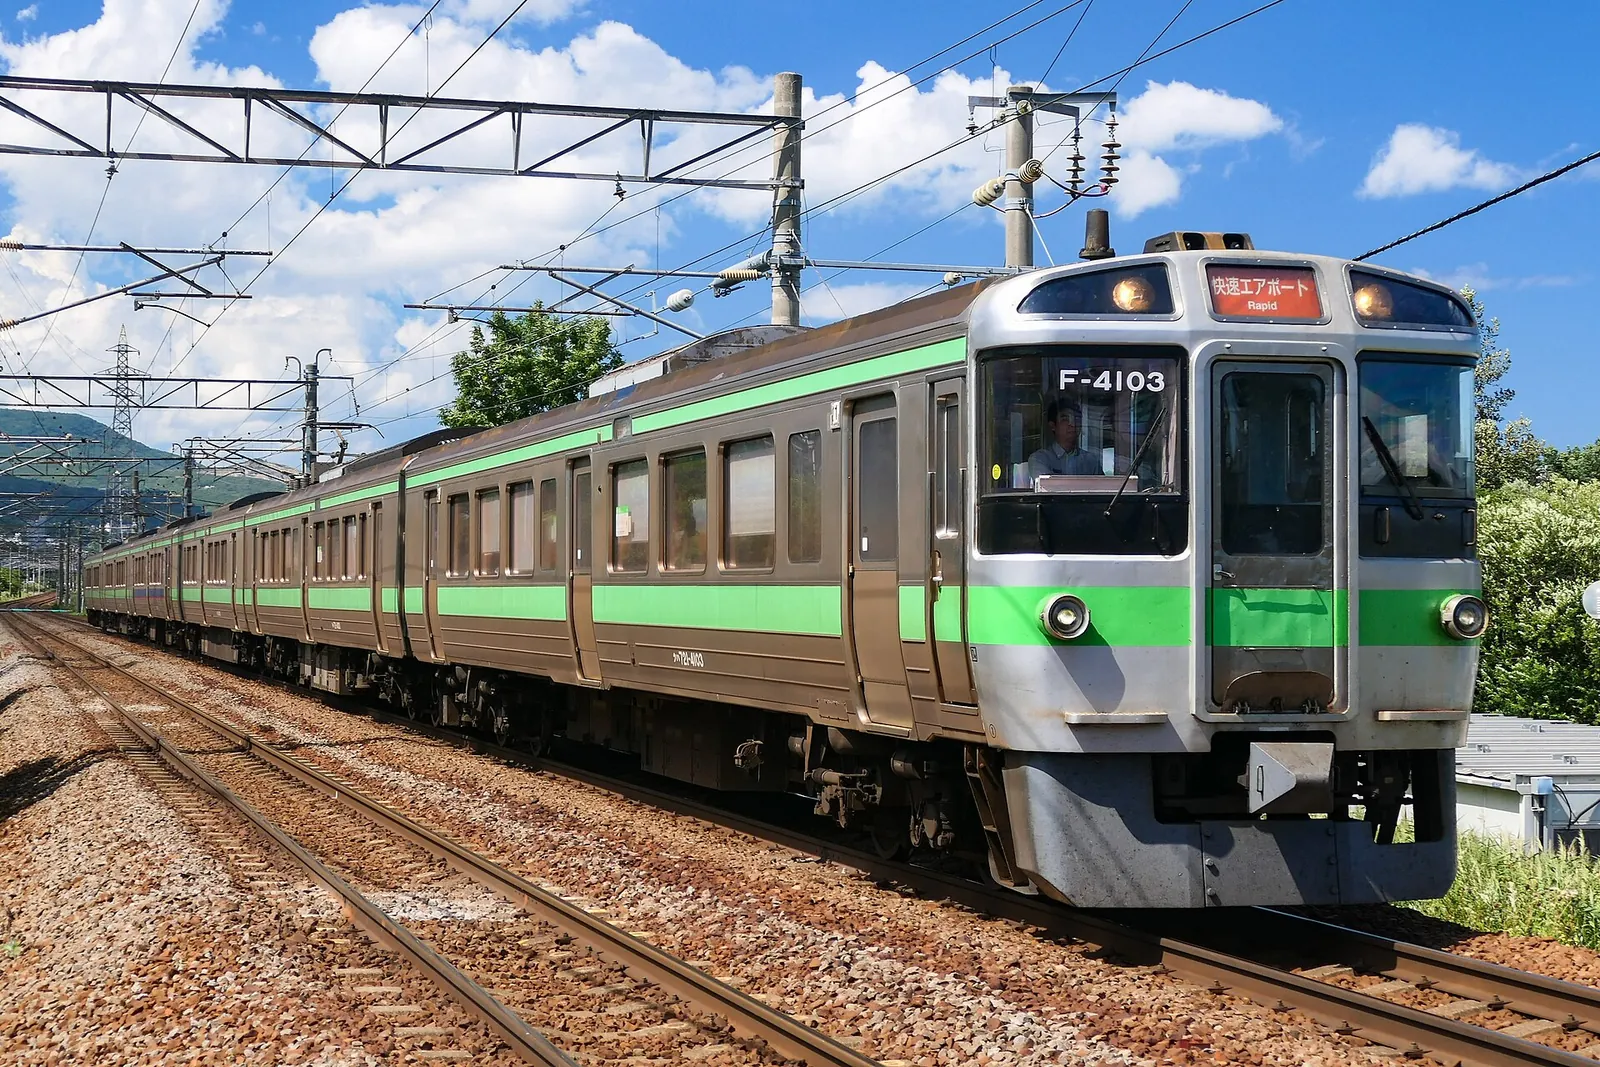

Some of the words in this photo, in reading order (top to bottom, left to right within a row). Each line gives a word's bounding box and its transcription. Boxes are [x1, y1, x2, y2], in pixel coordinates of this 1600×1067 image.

[1212, 275, 1308, 297] 快速エアポート
[1247, 301, 1278, 312] Rapid
[1060, 370, 1165, 392] F-4103
